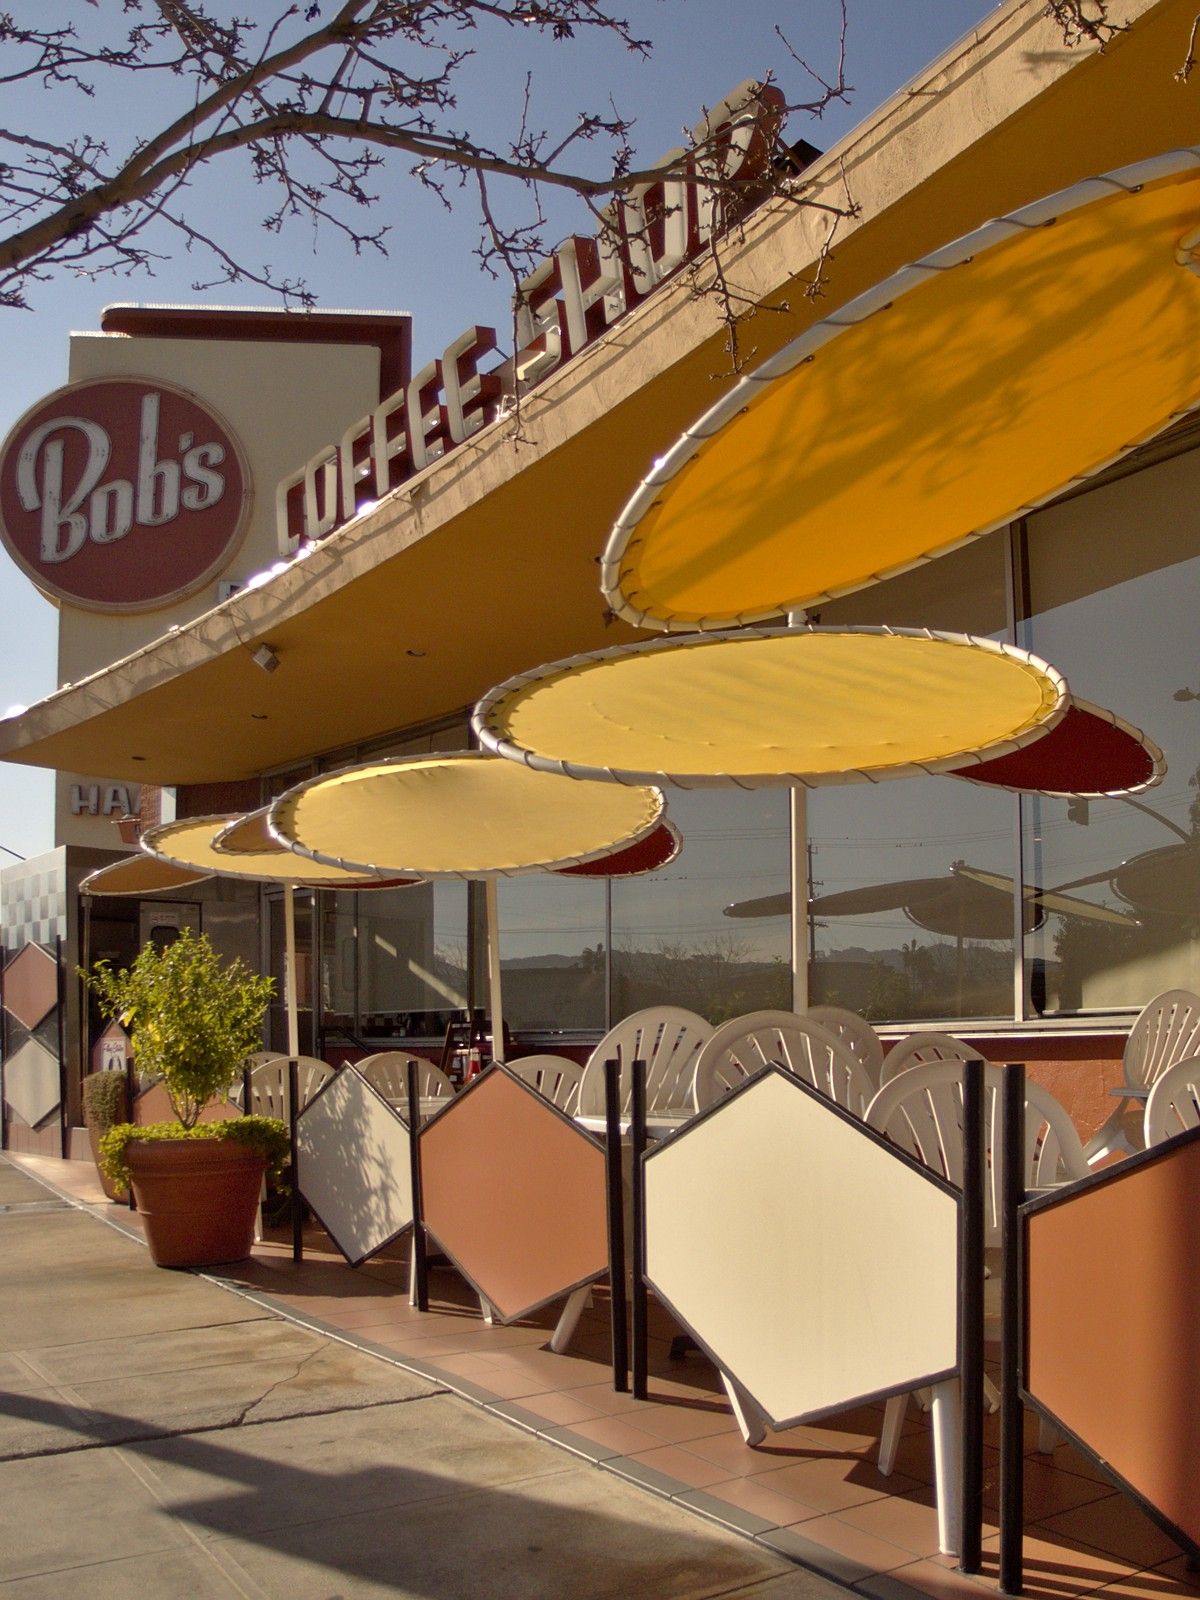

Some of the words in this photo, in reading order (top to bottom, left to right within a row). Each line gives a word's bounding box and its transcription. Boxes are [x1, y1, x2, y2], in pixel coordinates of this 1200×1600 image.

[276, 328, 492, 556] COFFEE
[512, 79, 776, 386] SHOP
[15, 392, 227, 564] Bob's
[71, 784, 140, 816] HA
